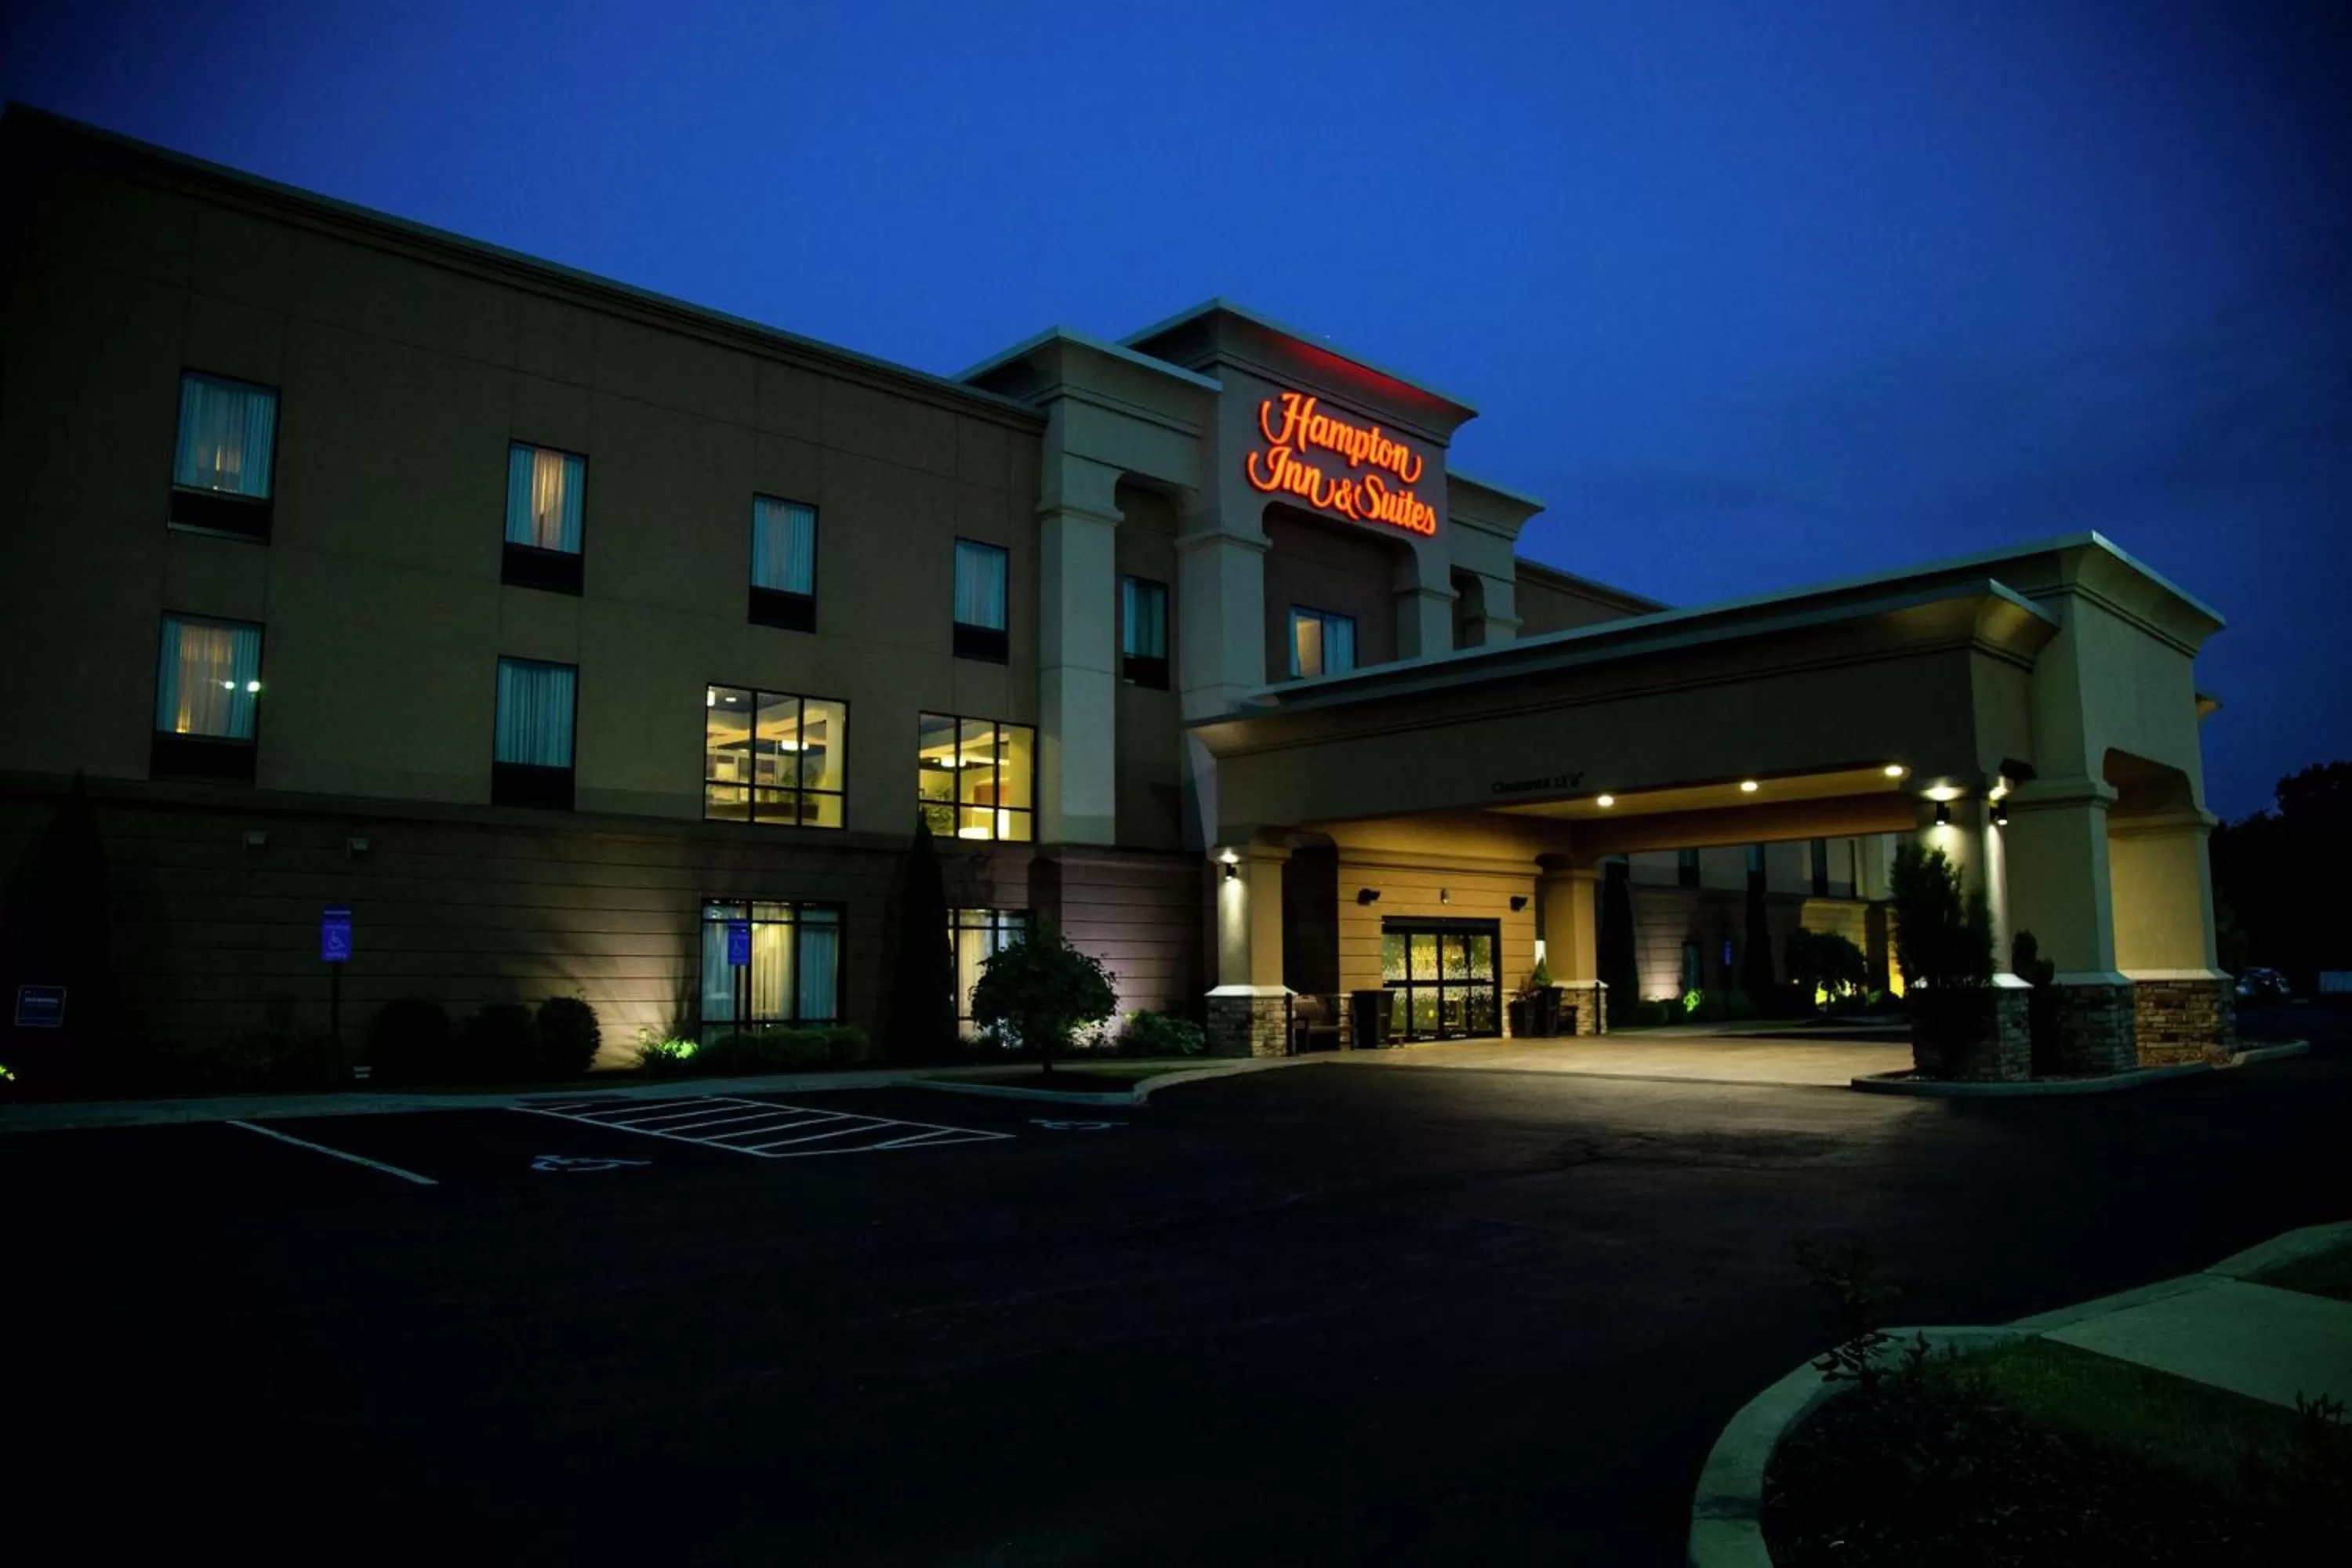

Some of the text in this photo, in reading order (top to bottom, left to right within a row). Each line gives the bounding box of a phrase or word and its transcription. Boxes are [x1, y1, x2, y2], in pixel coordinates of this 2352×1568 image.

[1261, 392, 1423, 484] Hampton
[1247, 445, 1436, 536] Inn & Suites
